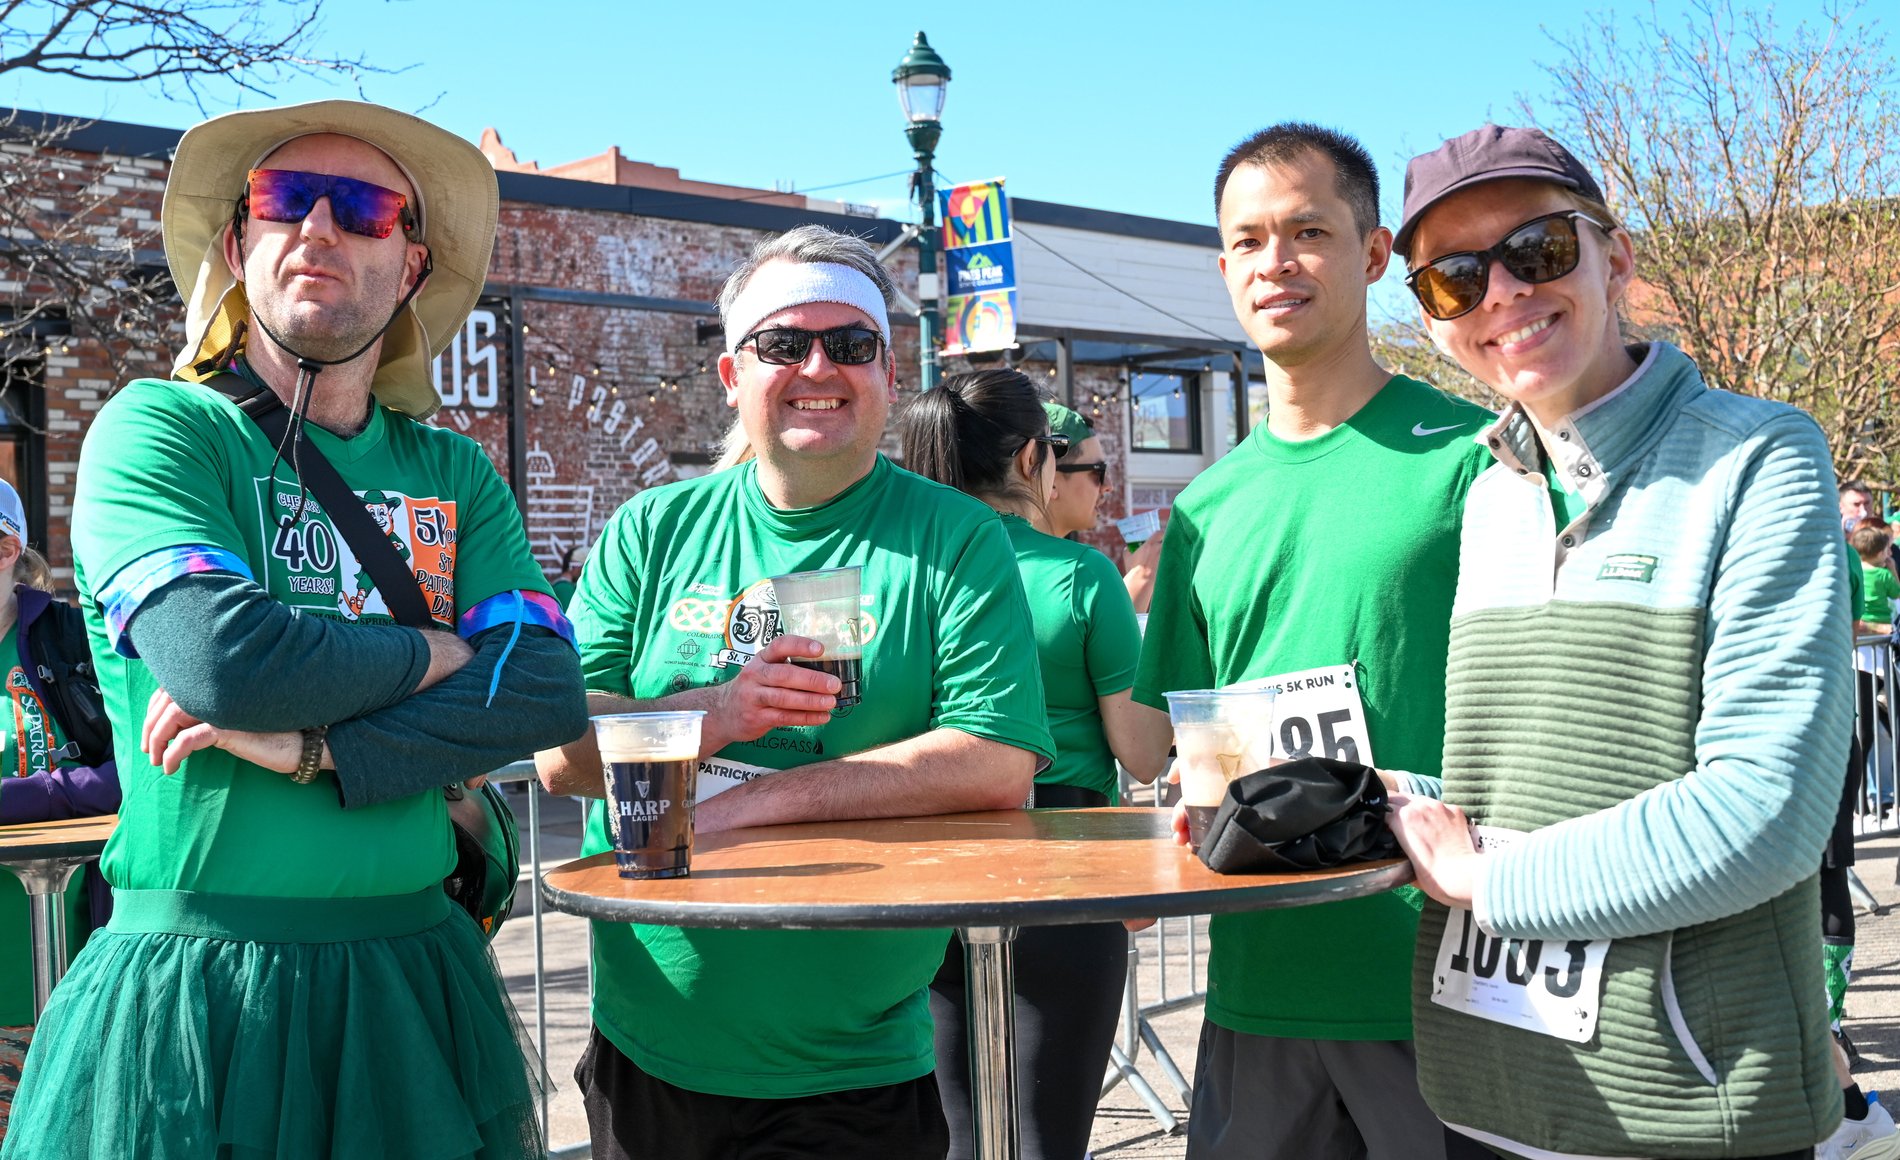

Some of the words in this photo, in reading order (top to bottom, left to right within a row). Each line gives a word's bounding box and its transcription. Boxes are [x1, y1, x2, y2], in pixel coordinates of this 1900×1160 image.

[272, 515, 337, 573] 40
[288, 576, 335, 595] YEARS!
[1286, 680, 1304, 692] 5K
[1305, 675, 1335, 689] RUN
[620, 800, 671, 816] HARP
